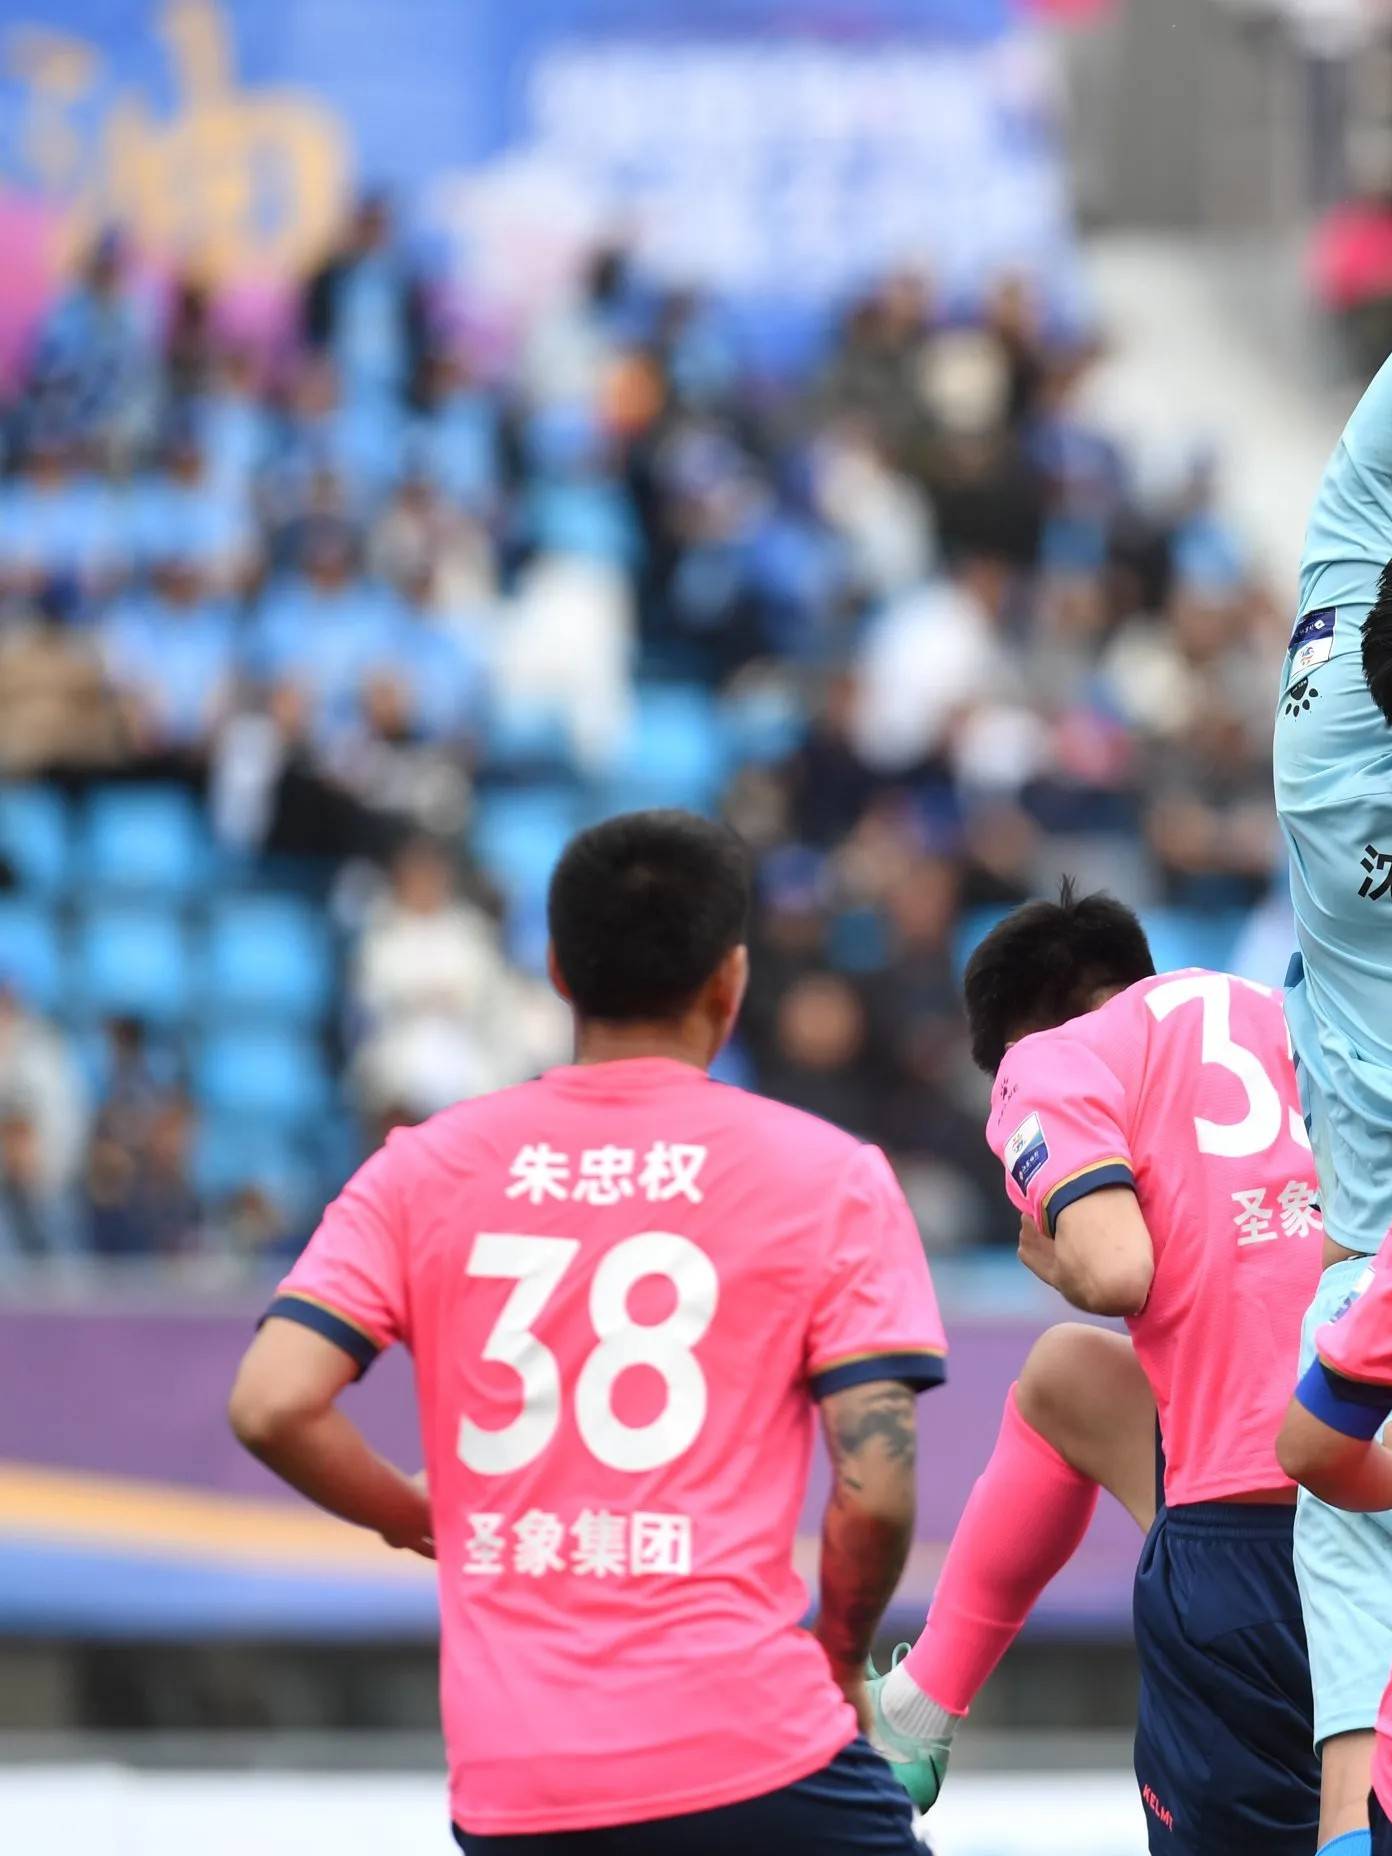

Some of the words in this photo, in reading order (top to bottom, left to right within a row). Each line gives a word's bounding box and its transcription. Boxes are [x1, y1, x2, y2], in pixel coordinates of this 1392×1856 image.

[1144, 974, 1312, 1158] 3
[505, 1141, 707, 1205] 朱忠权
[1231, 1180, 1324, 1247] 圣象
[456, 1231, 718, 1476] 38
[463, 1510, 692, 1577] 圣象集团
